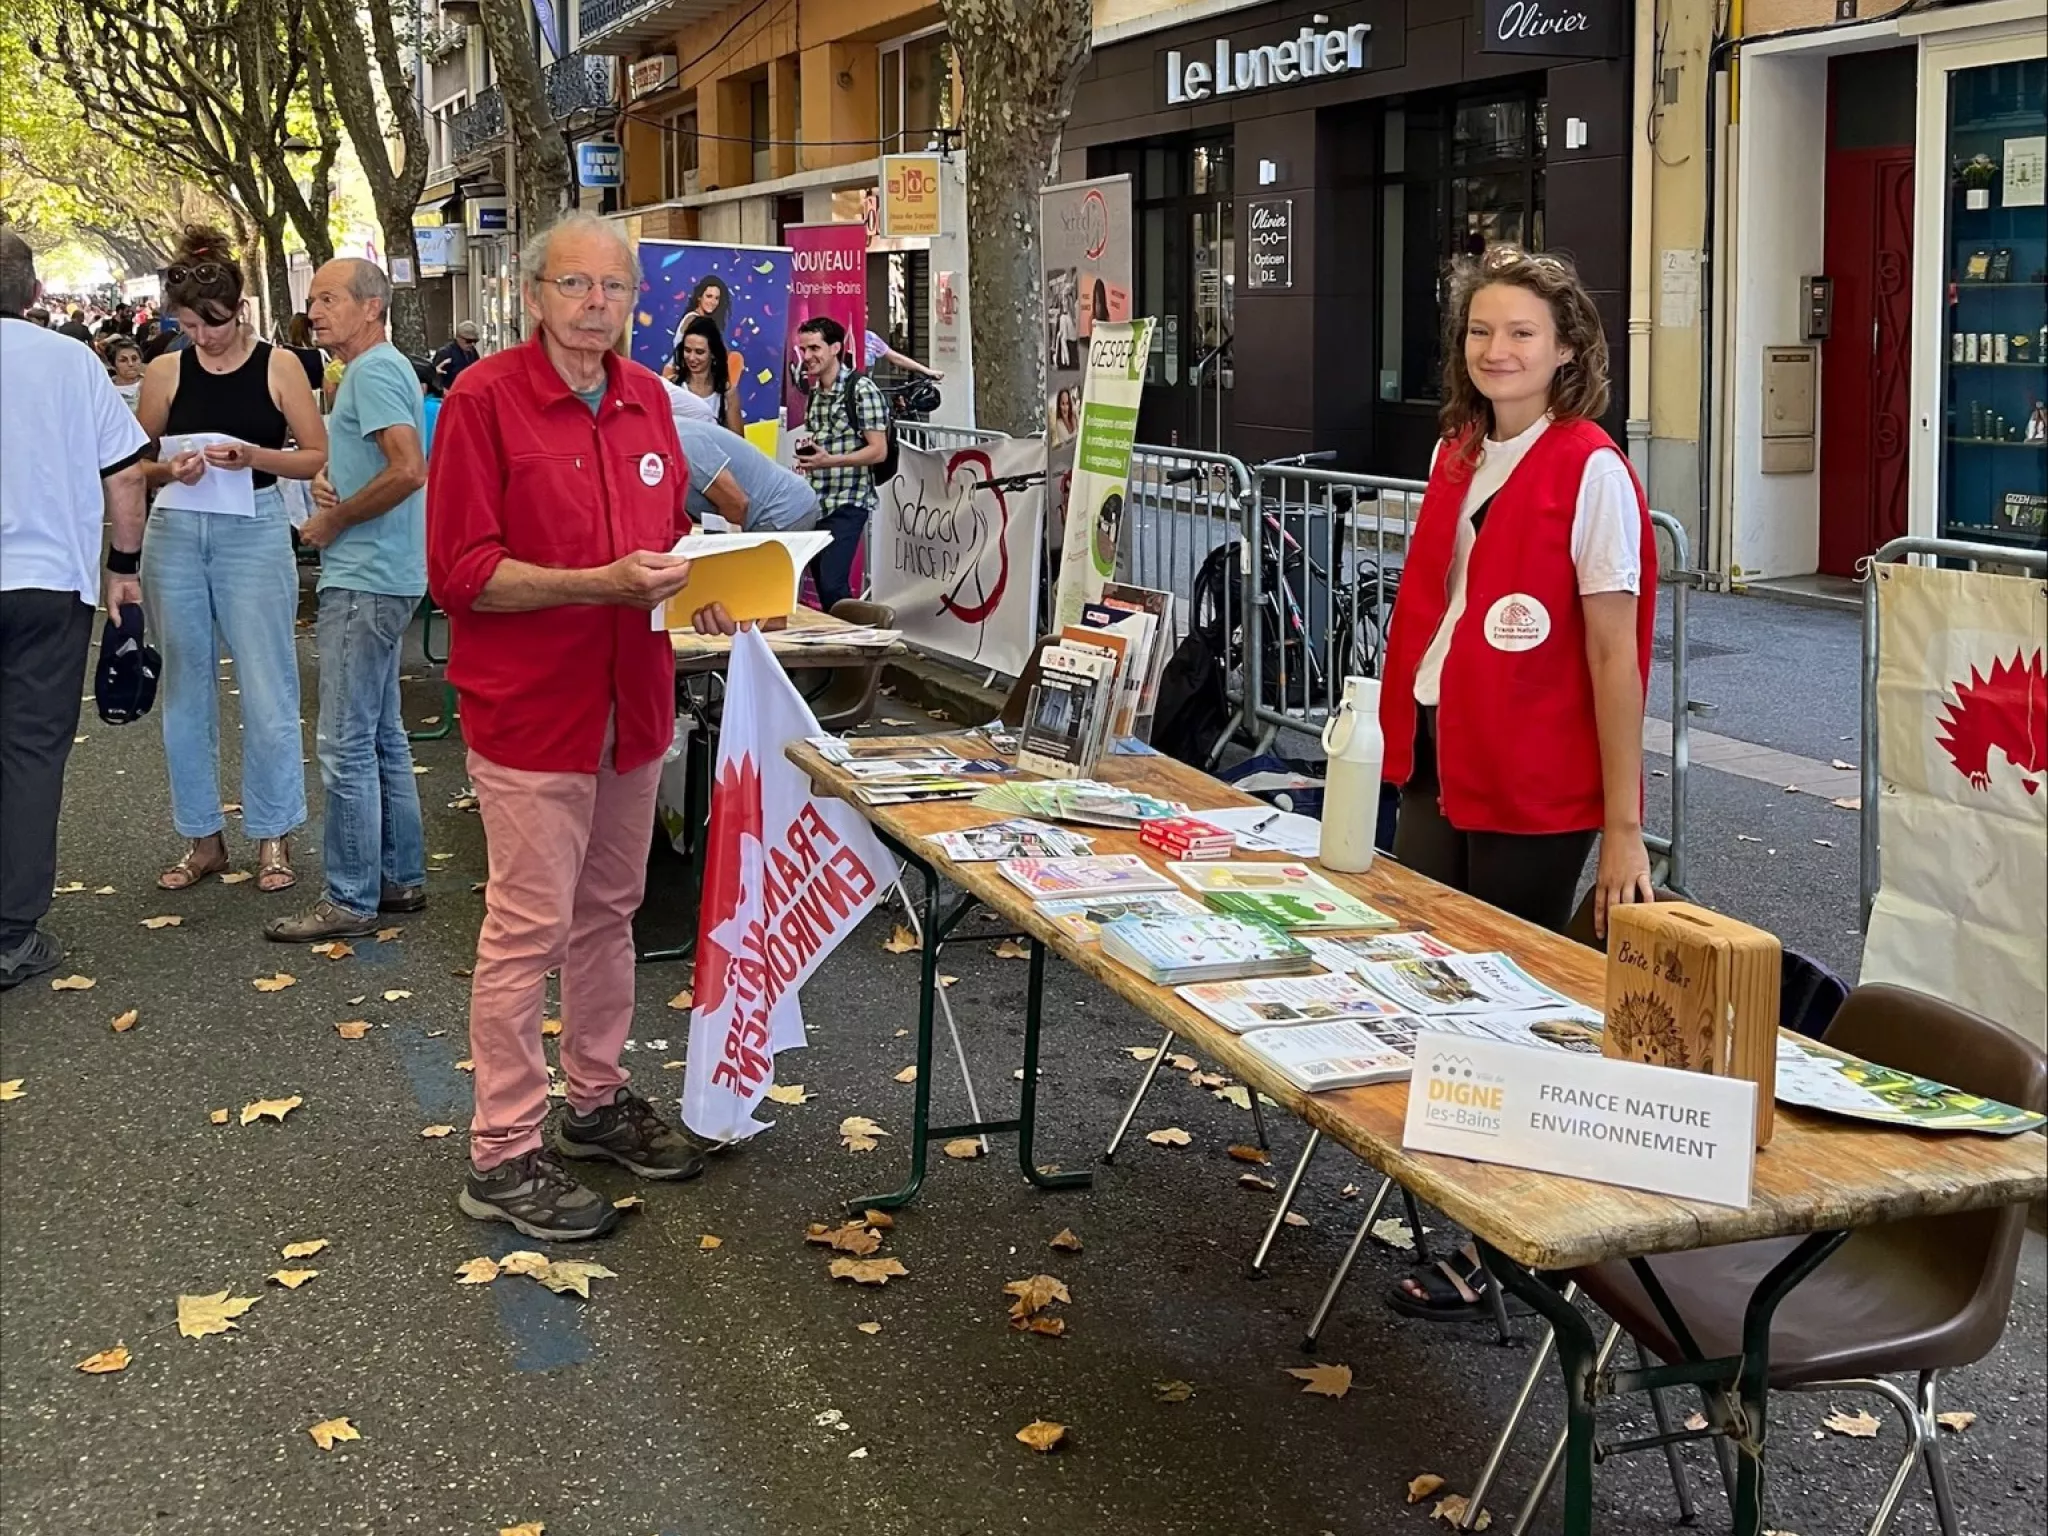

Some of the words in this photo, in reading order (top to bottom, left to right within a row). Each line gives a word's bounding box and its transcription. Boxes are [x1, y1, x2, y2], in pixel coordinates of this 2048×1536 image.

[1498, 1, 1592, 41] Olivier
[1167, 50, 1213, 104] Le
[1215, 14, 1372, 95] Lunetier
[586, 150, 618, 164] NEW
[791, 249, 853, 272] NOUVEAU
[1254, 252, 1286, 269] Opticien
[796, 281, 862, 299] Digne-les-Bains
[891, 473, 961, 546] School
[1428, 1078, 1505, 1110] DIGNE
[1539, 1083, 1620, 1113] FRANCE
[1625, 1097, 1711, 1129] NATURE
[1426, 1102, 1501, 1130] les-Bains
[1530, 1112, 1718, 1160] ENVIRONNEMENT
